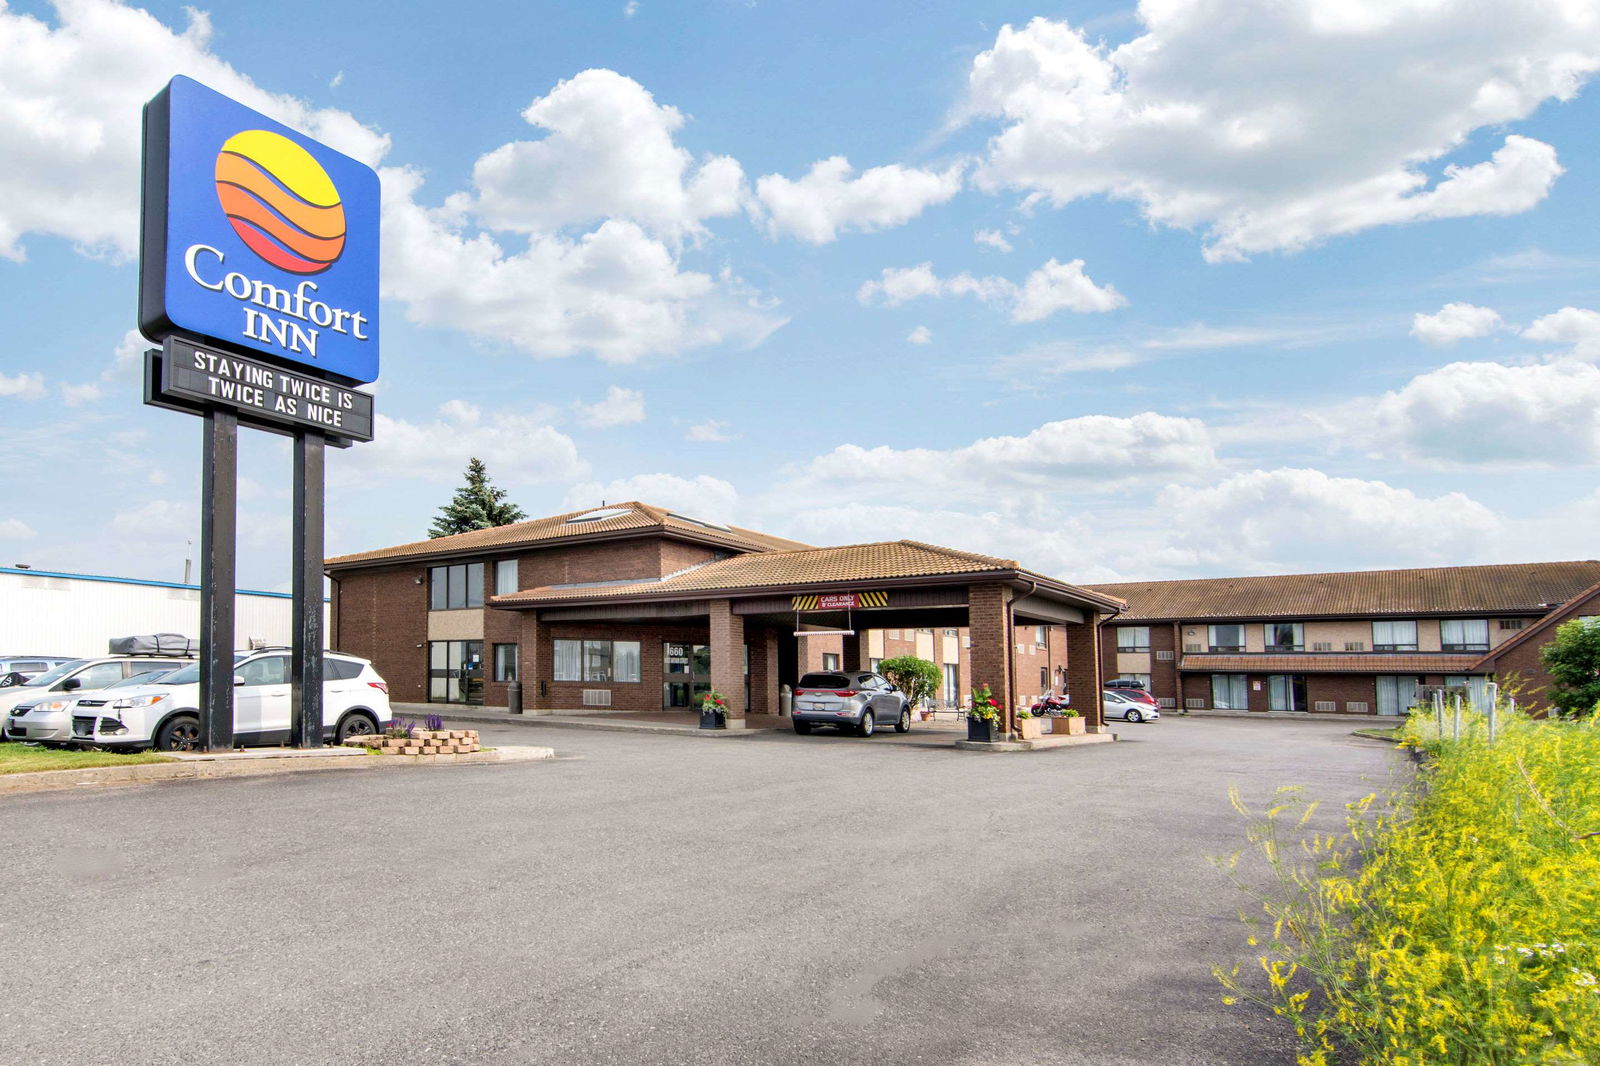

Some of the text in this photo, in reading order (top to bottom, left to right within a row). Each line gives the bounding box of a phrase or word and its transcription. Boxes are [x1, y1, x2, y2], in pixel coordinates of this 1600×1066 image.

[184, 244, 368, 340] Comfort
[243, 308, 319, 358] INN
[194, 351, 353, 410] STAYING TWICE IS
[208, 376, 342, 427] TWICE AS NICE
[669, 647, 684, 656] 660
